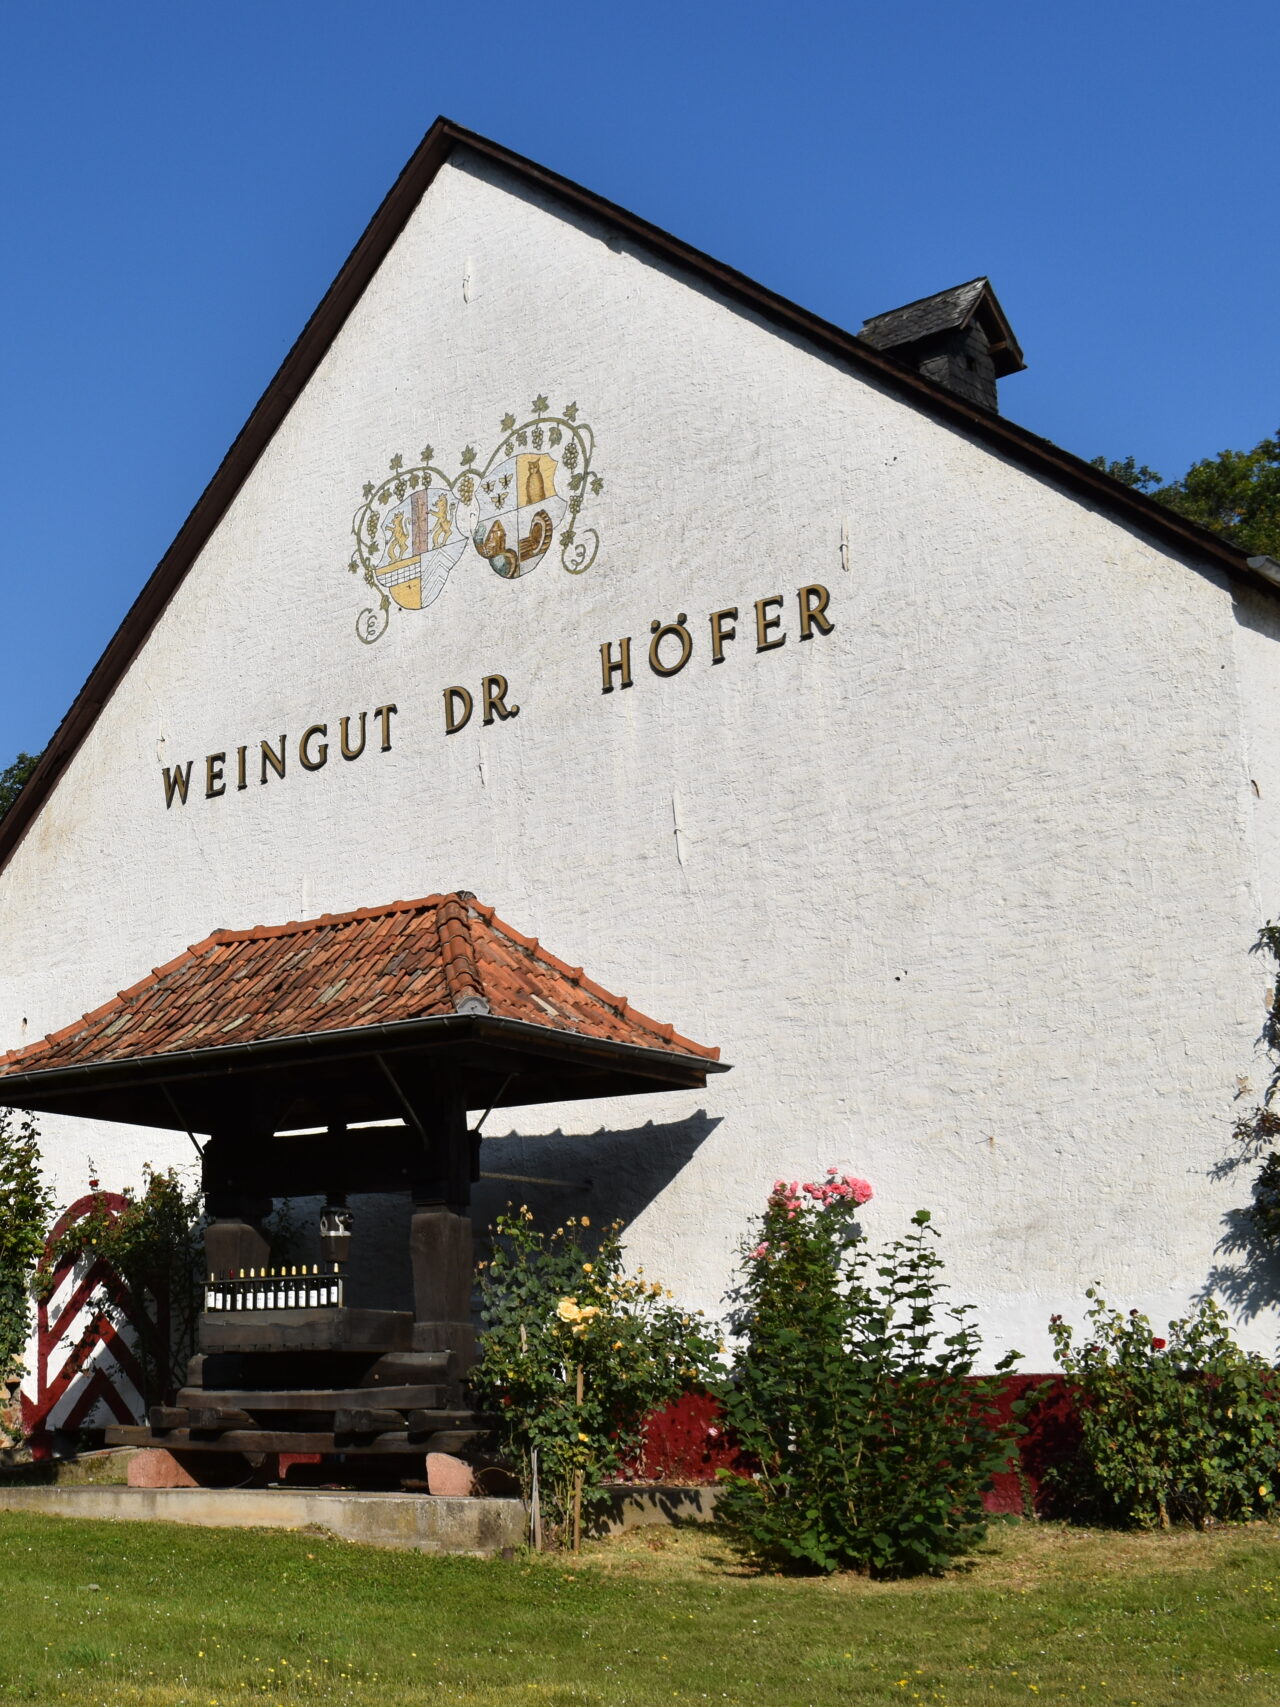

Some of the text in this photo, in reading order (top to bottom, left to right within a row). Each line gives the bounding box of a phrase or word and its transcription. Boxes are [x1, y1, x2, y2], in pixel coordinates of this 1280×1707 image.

[161, 583, 835, 808] WEINGUT DR. HÖFER
